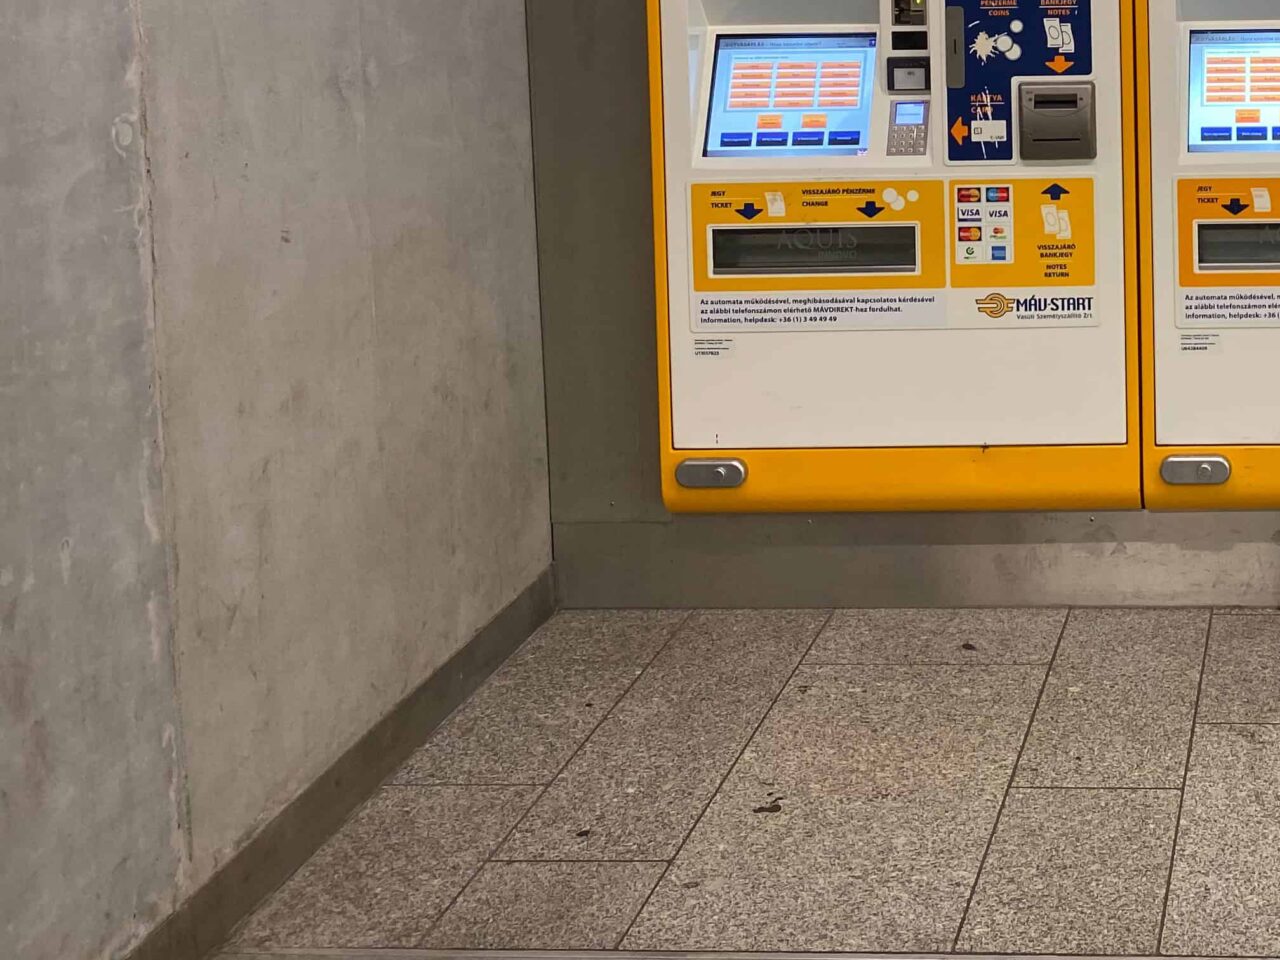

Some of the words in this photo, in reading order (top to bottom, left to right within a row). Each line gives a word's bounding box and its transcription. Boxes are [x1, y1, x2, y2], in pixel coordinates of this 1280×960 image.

[960, 208, 980, 216] VISA
[988, 210, 1008, 218] VISA
[1016, 294, 1094, 312] MÁV-START
[744, 316, 776, 324] helpdesk:
[1228, 312, 1262, 320] helpdesk:
